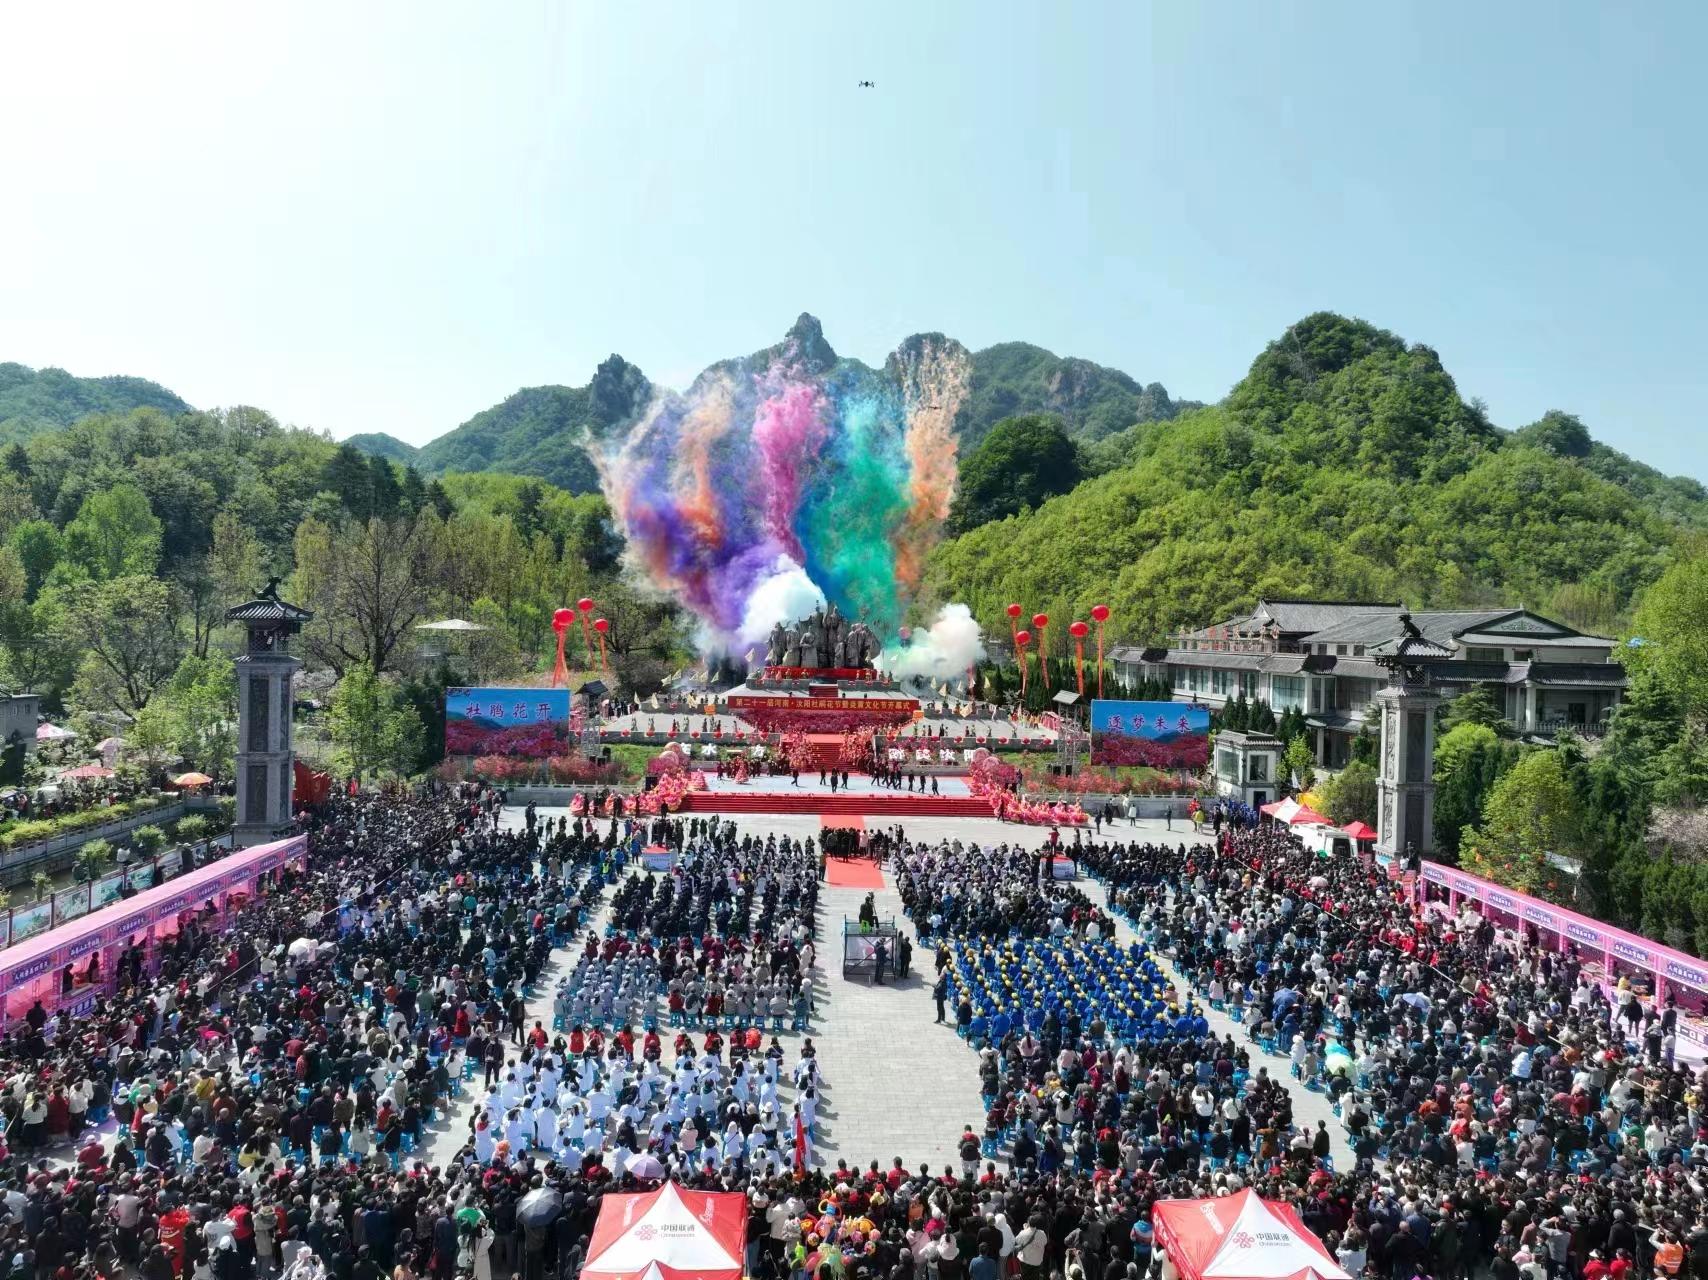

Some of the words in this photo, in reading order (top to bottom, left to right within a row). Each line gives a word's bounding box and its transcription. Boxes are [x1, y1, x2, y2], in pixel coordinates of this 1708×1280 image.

[466, 702, 551, 719] 杜鹃花开
[1108, 713, 1192, 733] 逐梦未来
[661, 1223, 695, 1232] 中国联通
[1256, 1232, 1289, 1241] 中国联通
